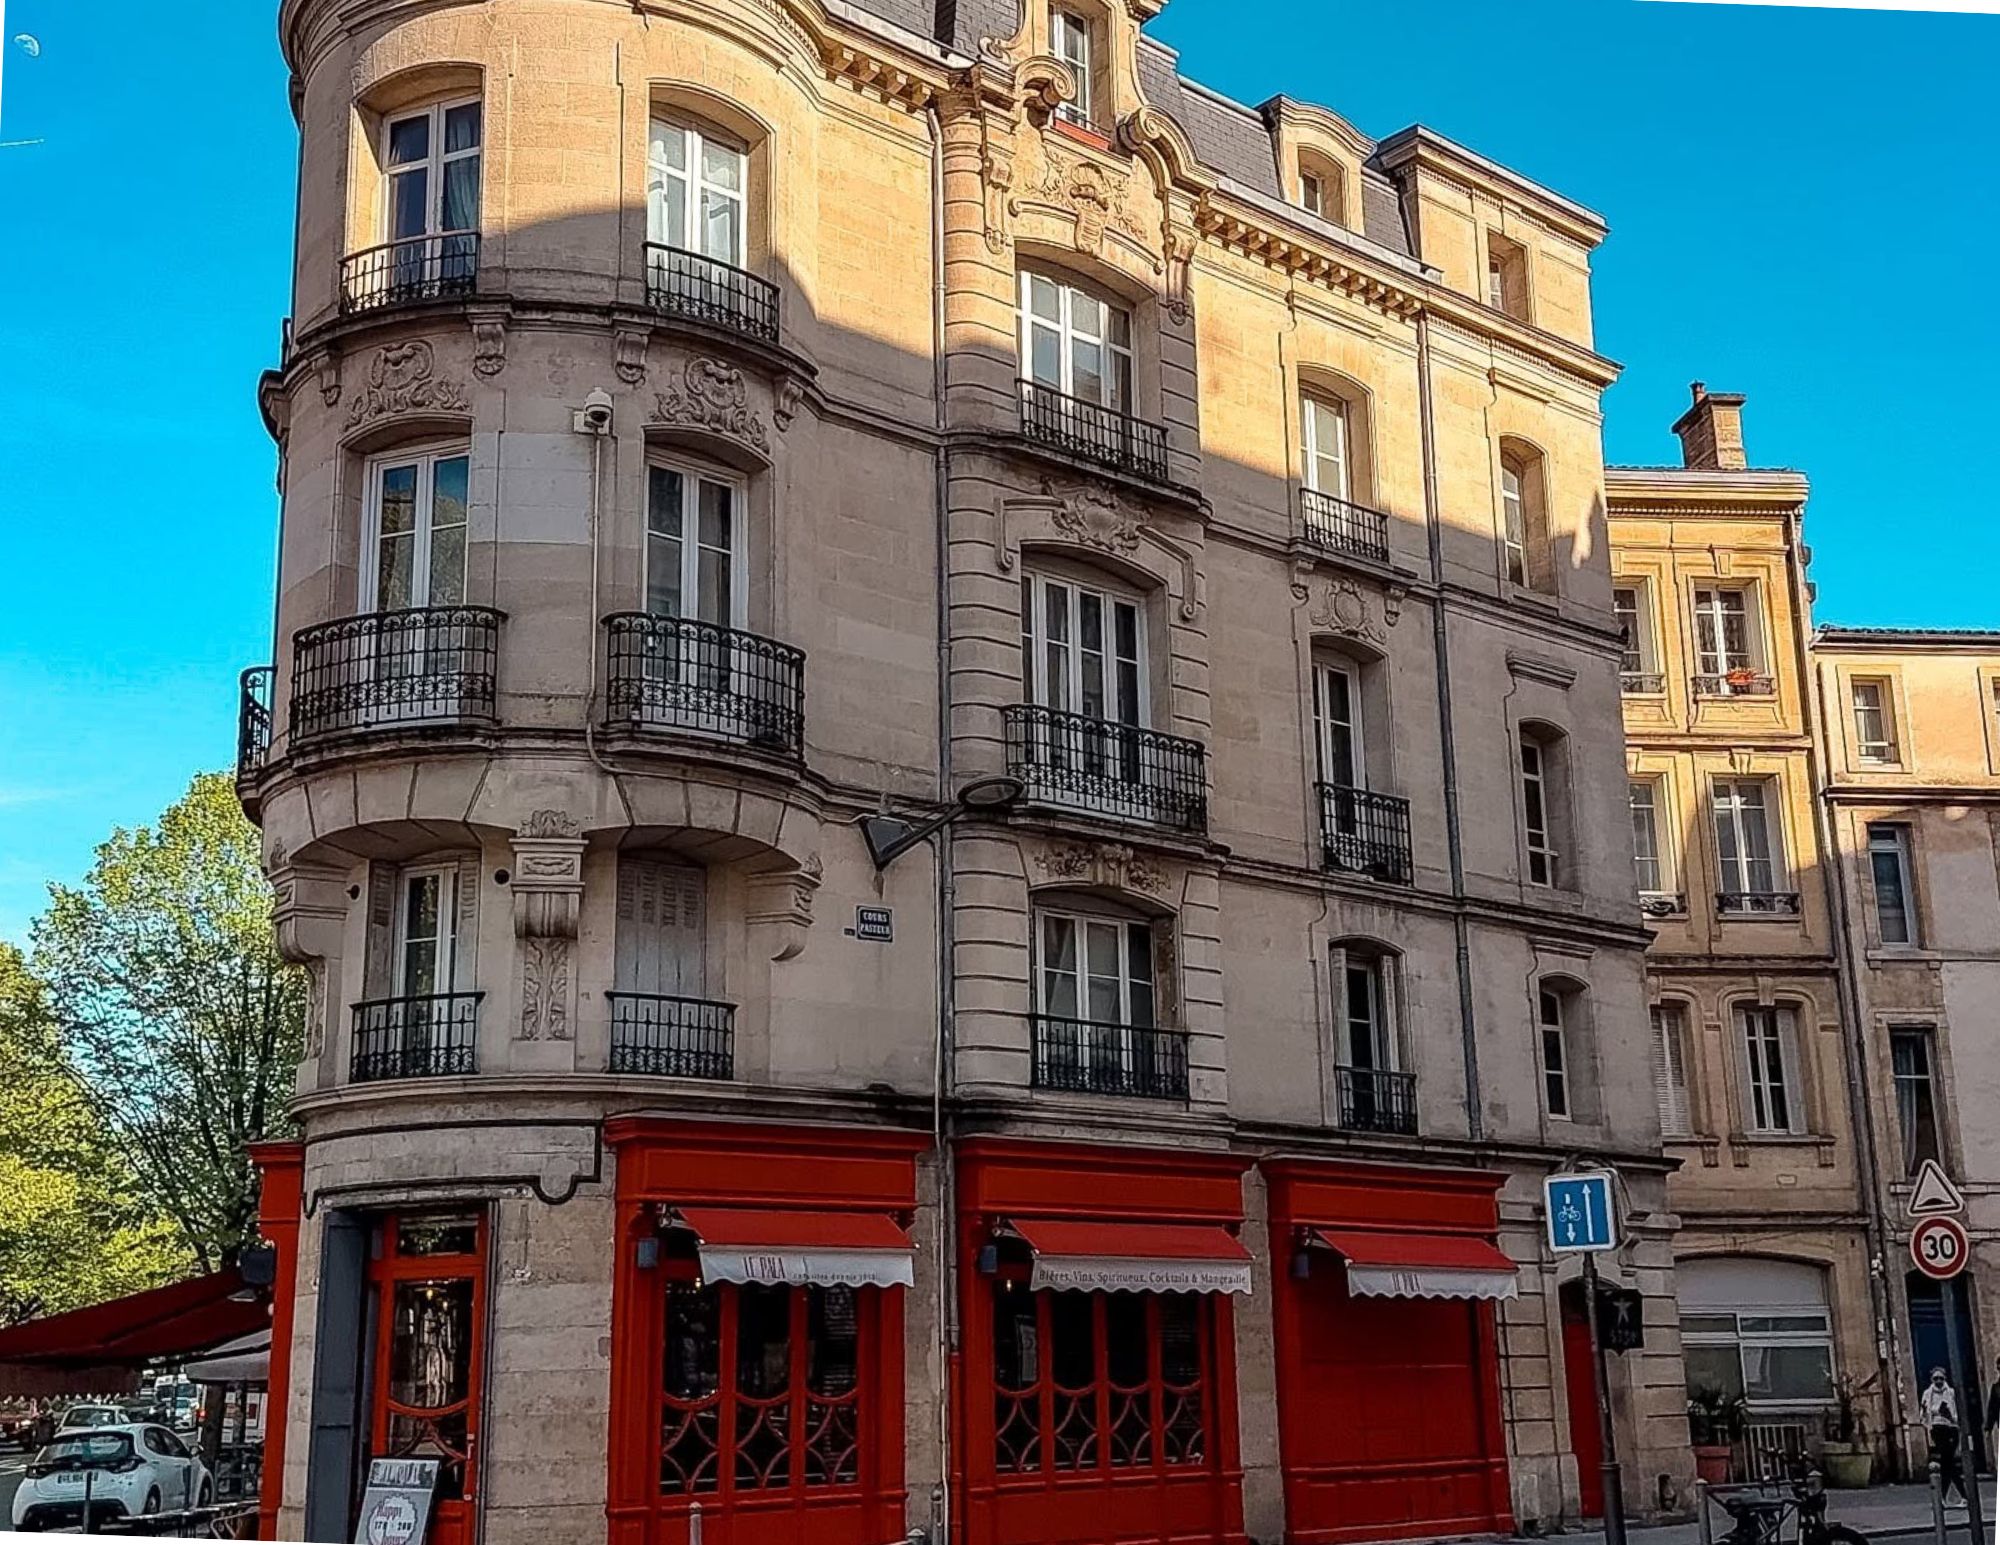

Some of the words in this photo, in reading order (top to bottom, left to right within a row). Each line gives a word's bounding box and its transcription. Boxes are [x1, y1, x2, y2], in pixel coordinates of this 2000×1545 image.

[862, 911, 888, 923] COURS
[860, 923, 890, 935] PASTEUR
[1923, 1234, 1956, 1260] 30
[1149, 1272, 1189, 1284] Cocktails
[1191, 1273, 1198, 1283] &
